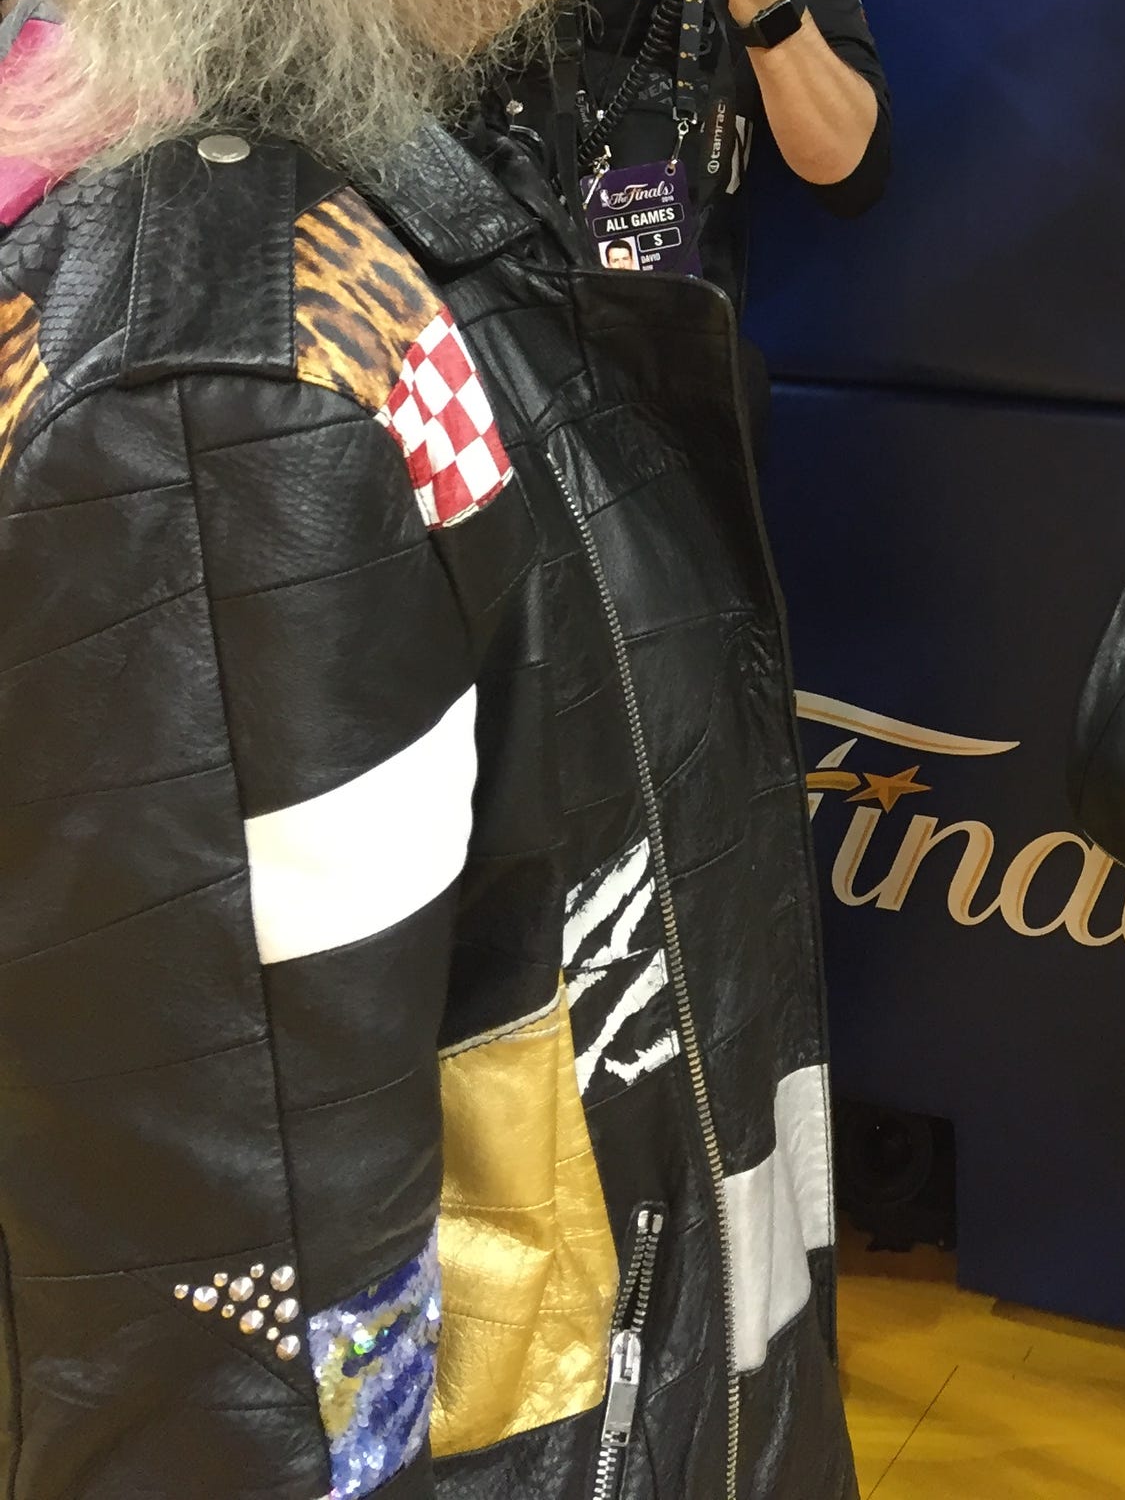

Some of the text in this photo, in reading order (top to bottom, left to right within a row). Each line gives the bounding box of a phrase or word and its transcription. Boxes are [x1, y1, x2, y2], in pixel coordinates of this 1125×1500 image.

[710, 101, 726, 159] tamrac
[622, 181, 674, 207] Finals
[606, 207, 675, 232] ALL GAMES
[653, 233, 663, 247] S
[640, 252, 661, 264] DAVID
